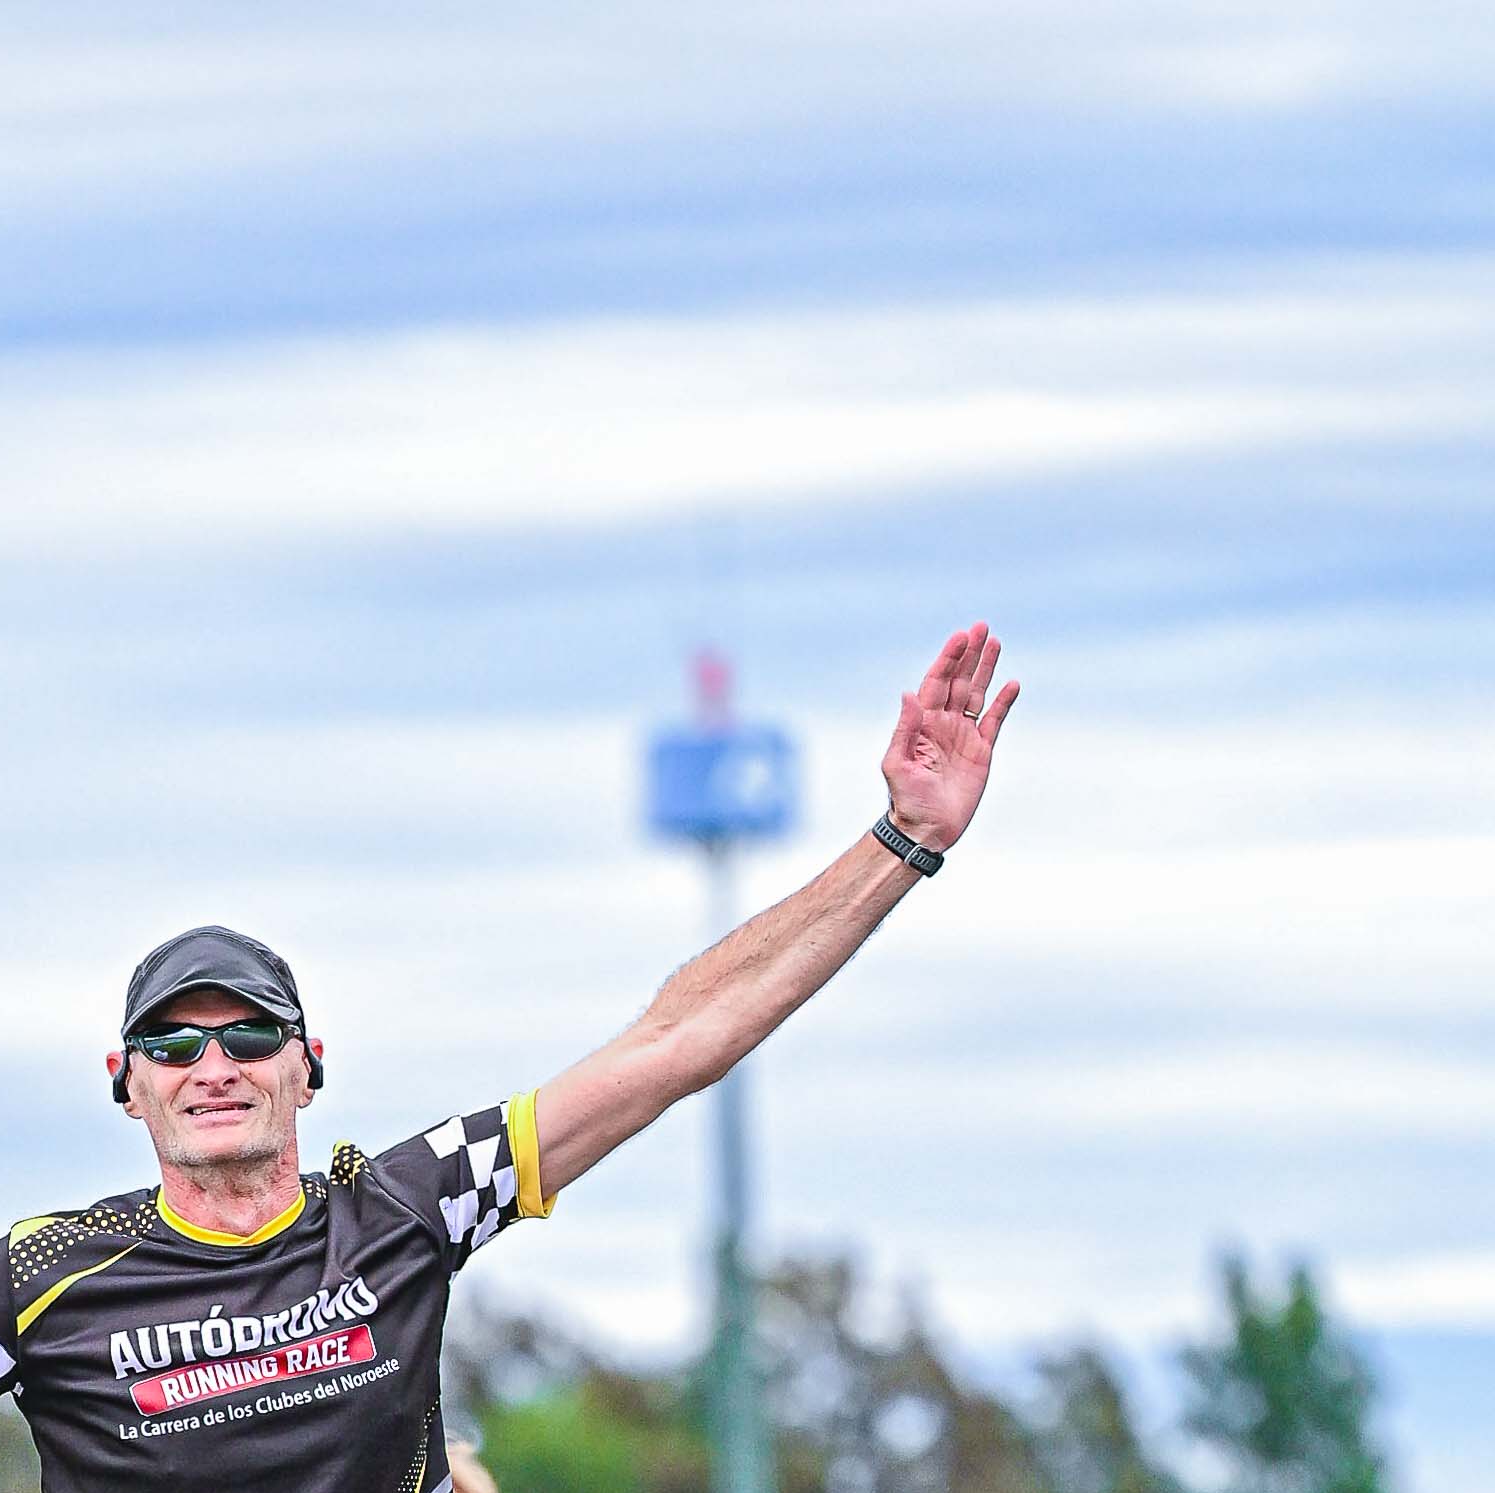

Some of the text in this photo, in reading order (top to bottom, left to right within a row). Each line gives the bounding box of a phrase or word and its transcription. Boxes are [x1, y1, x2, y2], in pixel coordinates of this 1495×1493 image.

[109, 1276, 379, 1380] AUTÓDROMO
[118, 1358, 401, 1440] La Carrera de los Clubes del Noroeste
[160, 1336, 351, 1406] RUNNING RACE
